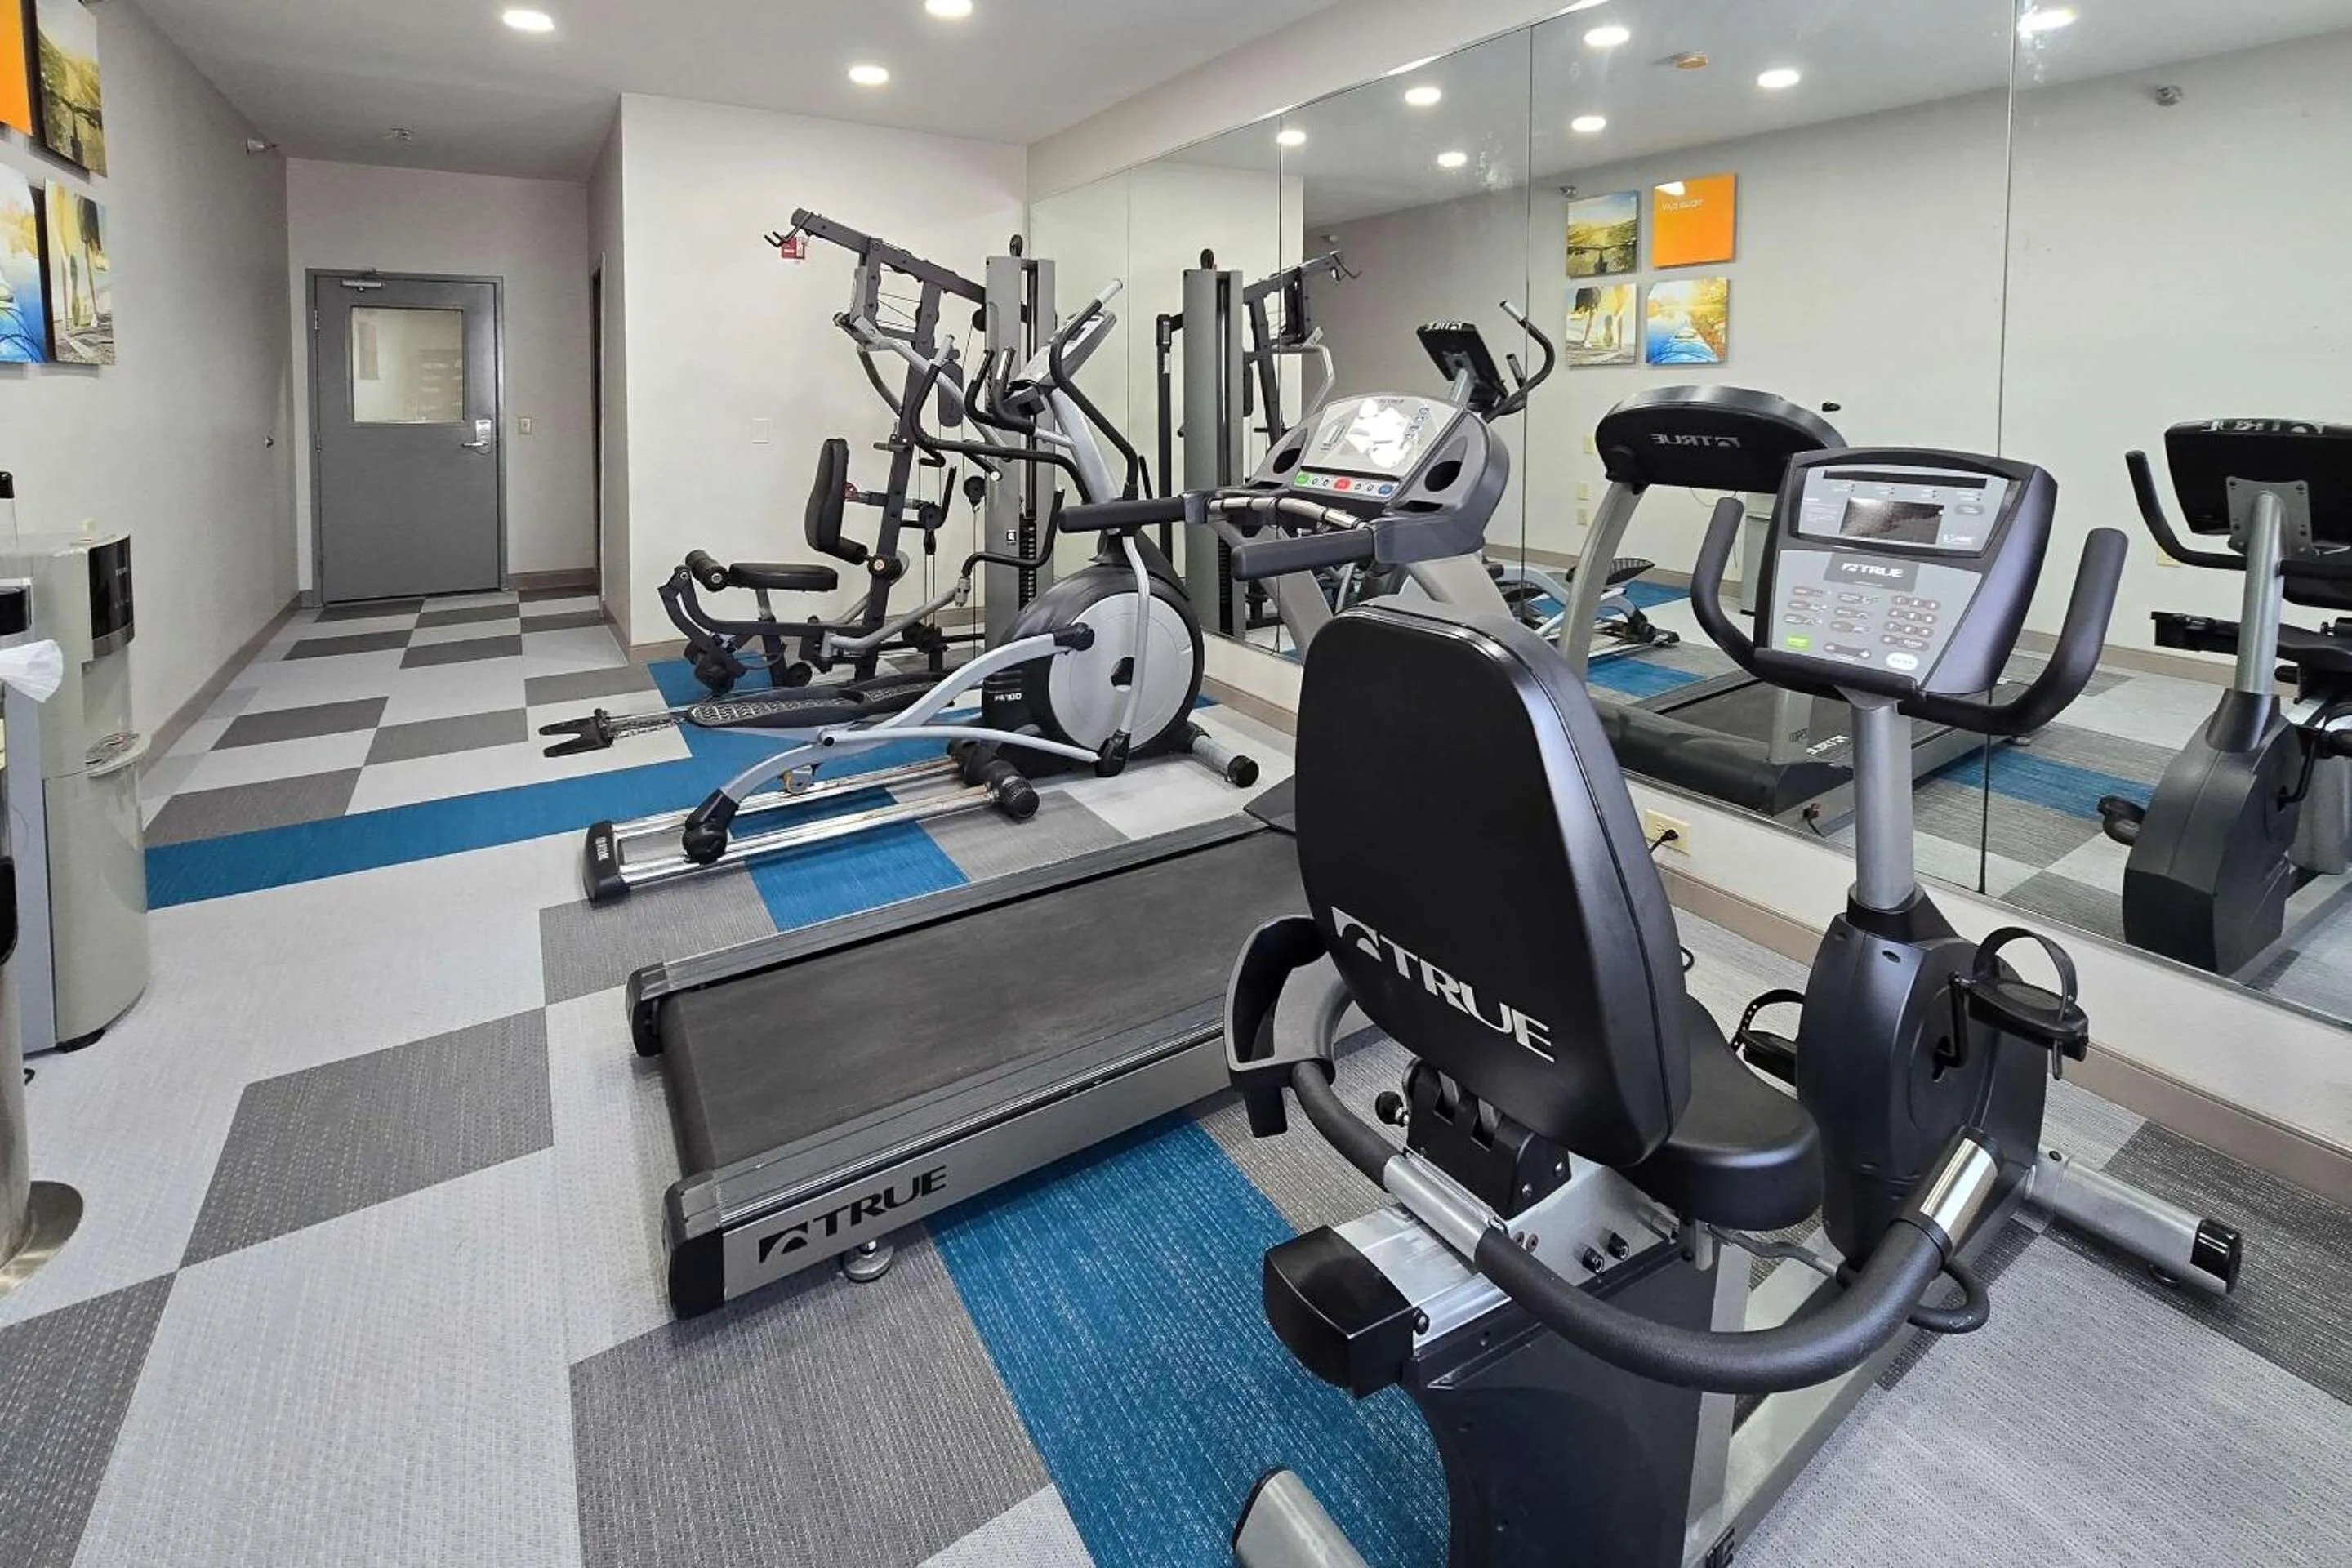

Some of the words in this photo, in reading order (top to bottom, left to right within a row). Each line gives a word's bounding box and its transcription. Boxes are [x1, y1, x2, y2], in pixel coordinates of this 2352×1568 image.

[1859, 564, 1904, 578] TRUE
[1379, 934, 1555, 1062] TRUE
[813, 1165, 947, 1237] TRUE
